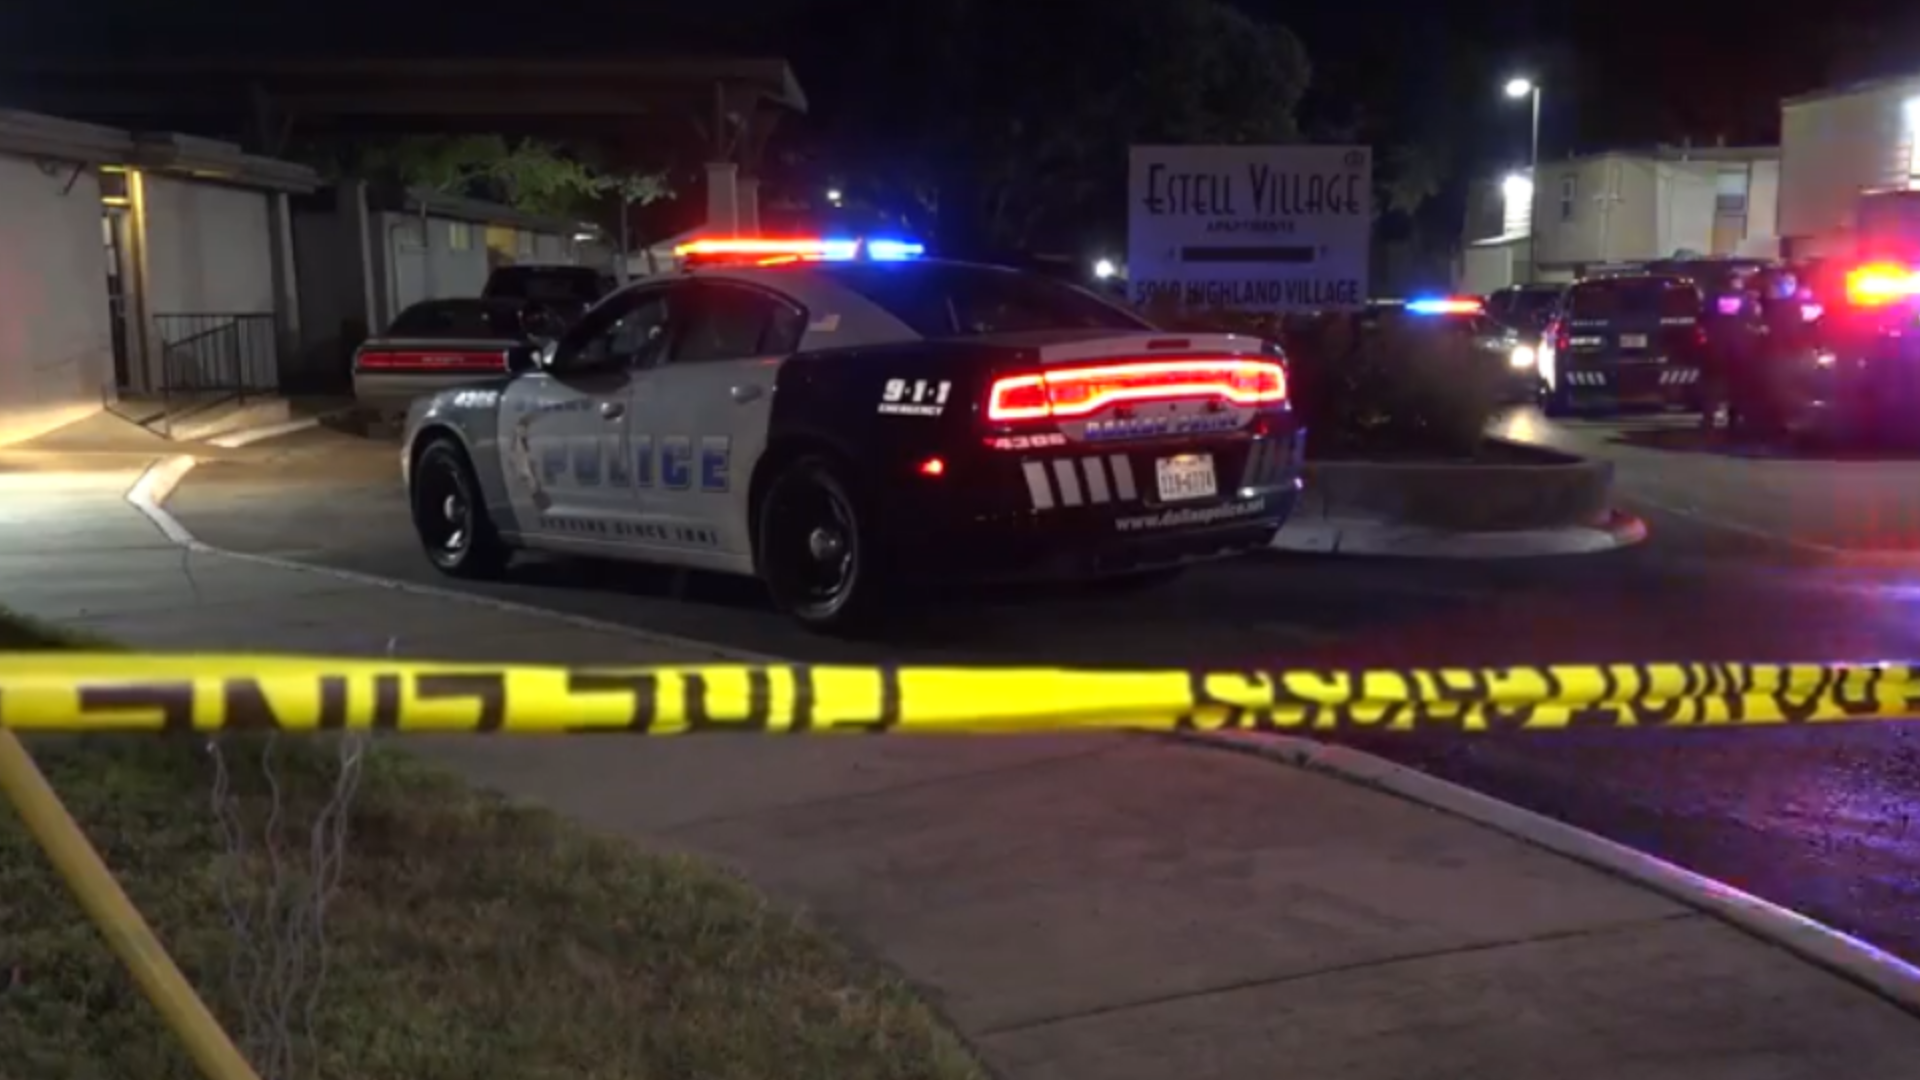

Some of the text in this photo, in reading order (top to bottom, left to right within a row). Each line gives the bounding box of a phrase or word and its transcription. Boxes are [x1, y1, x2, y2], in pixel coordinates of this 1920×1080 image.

[1142, 163, 1361, 216] ESTELL VILLAGE
[1186, 280, 1281, 303] HIGHLAND
[1284, 280, 1359, 303] VILLAGE
[540, 434, 732, 492] POLICE
